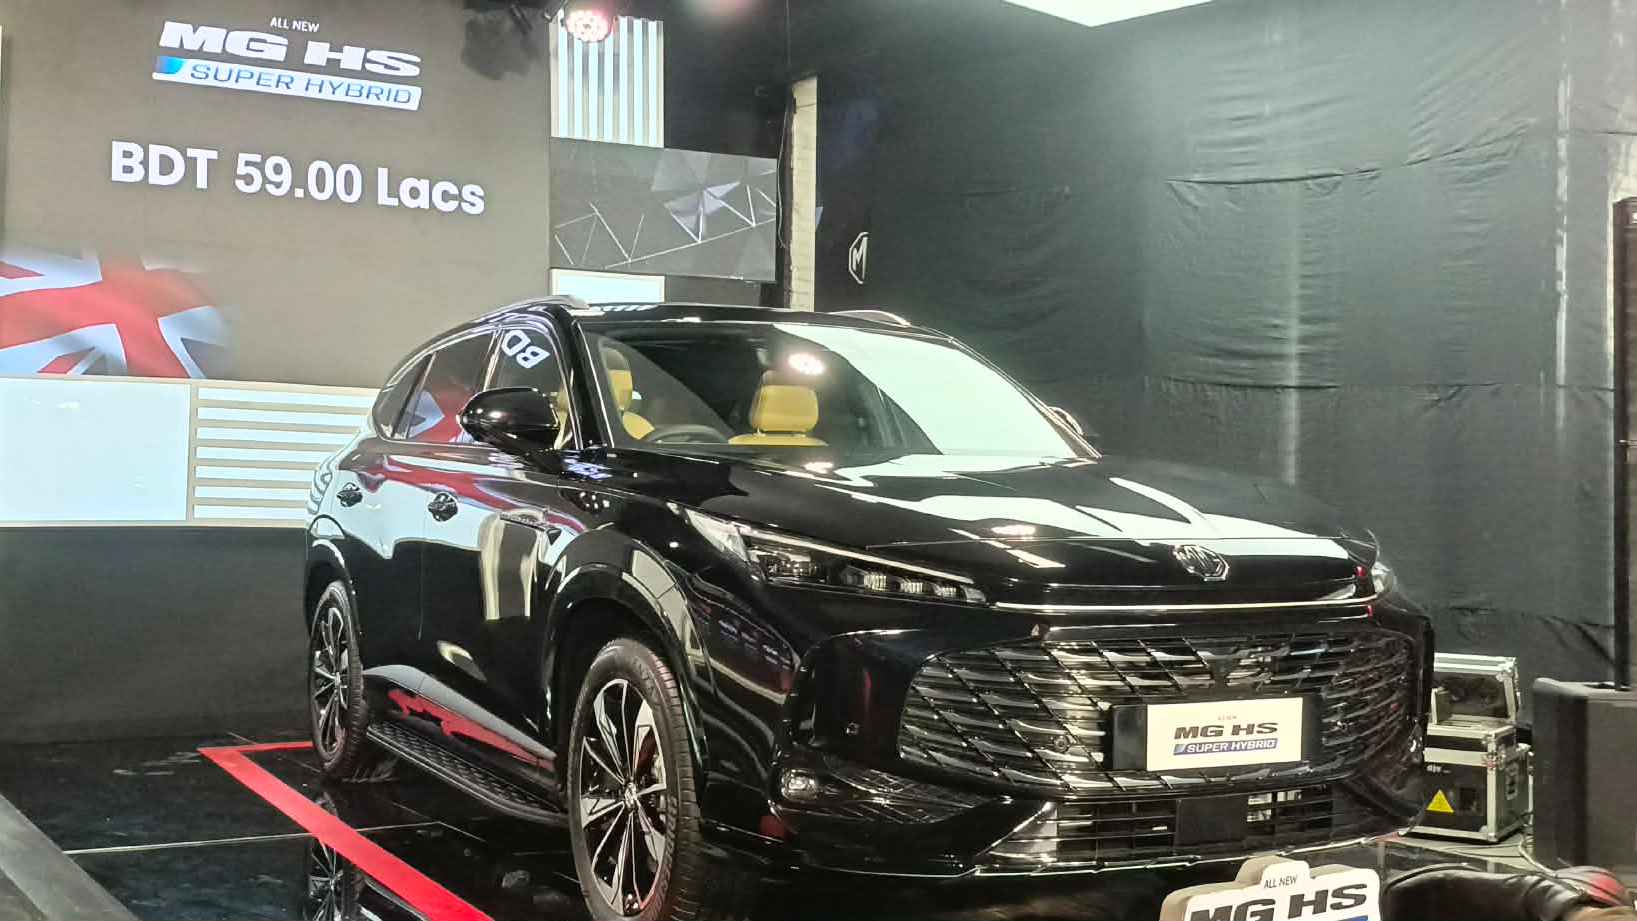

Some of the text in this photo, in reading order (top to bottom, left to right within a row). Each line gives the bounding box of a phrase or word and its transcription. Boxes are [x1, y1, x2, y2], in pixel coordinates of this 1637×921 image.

[270, 16, 320, 33] ALL NEW
[159, 20, 422, 77] MG HS
[190, 63, 413, 104] SUPER HYBRID
[111, 140, 485, 215] BDT 59.00 Lacs
[1174, 722, 1279, 740] MG HS
[1186, 739, 1276, 753] SUPER HYBRID
[1264, 875, 1298, 889] ALL NEW
[1287, 883, 1368, 920] HS
